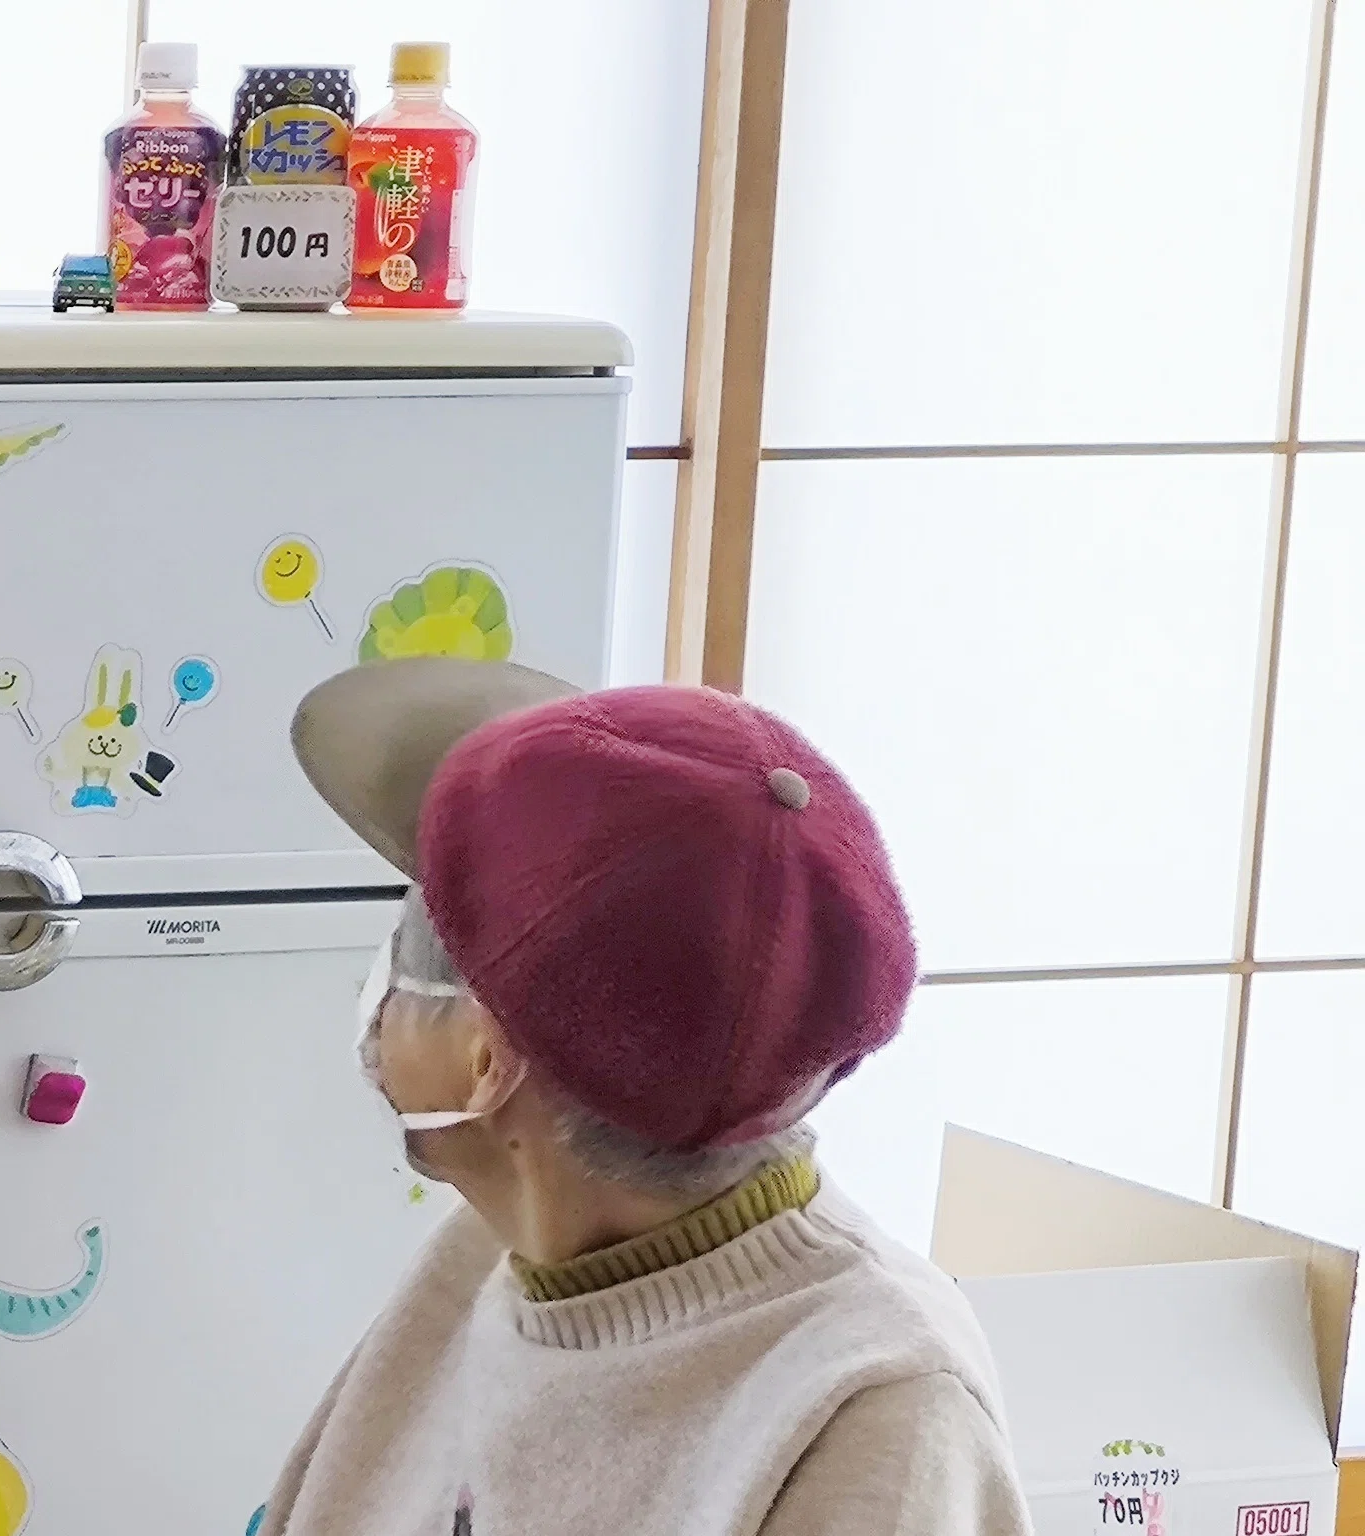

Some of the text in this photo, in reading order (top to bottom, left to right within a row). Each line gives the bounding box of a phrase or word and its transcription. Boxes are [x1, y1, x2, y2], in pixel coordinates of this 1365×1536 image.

[264, 121, 335, 146] レモン
[136, 140, 189, 153] Ribbon
[246, 148, 347, 173] スカッシュ
[124, 175, 200, 208] ゼリー
[167, 920, 221, 933] MORITA
[1098, 1497, 1144, 1525] 70円
[1244, 1506, 1302, 1536] 05001
